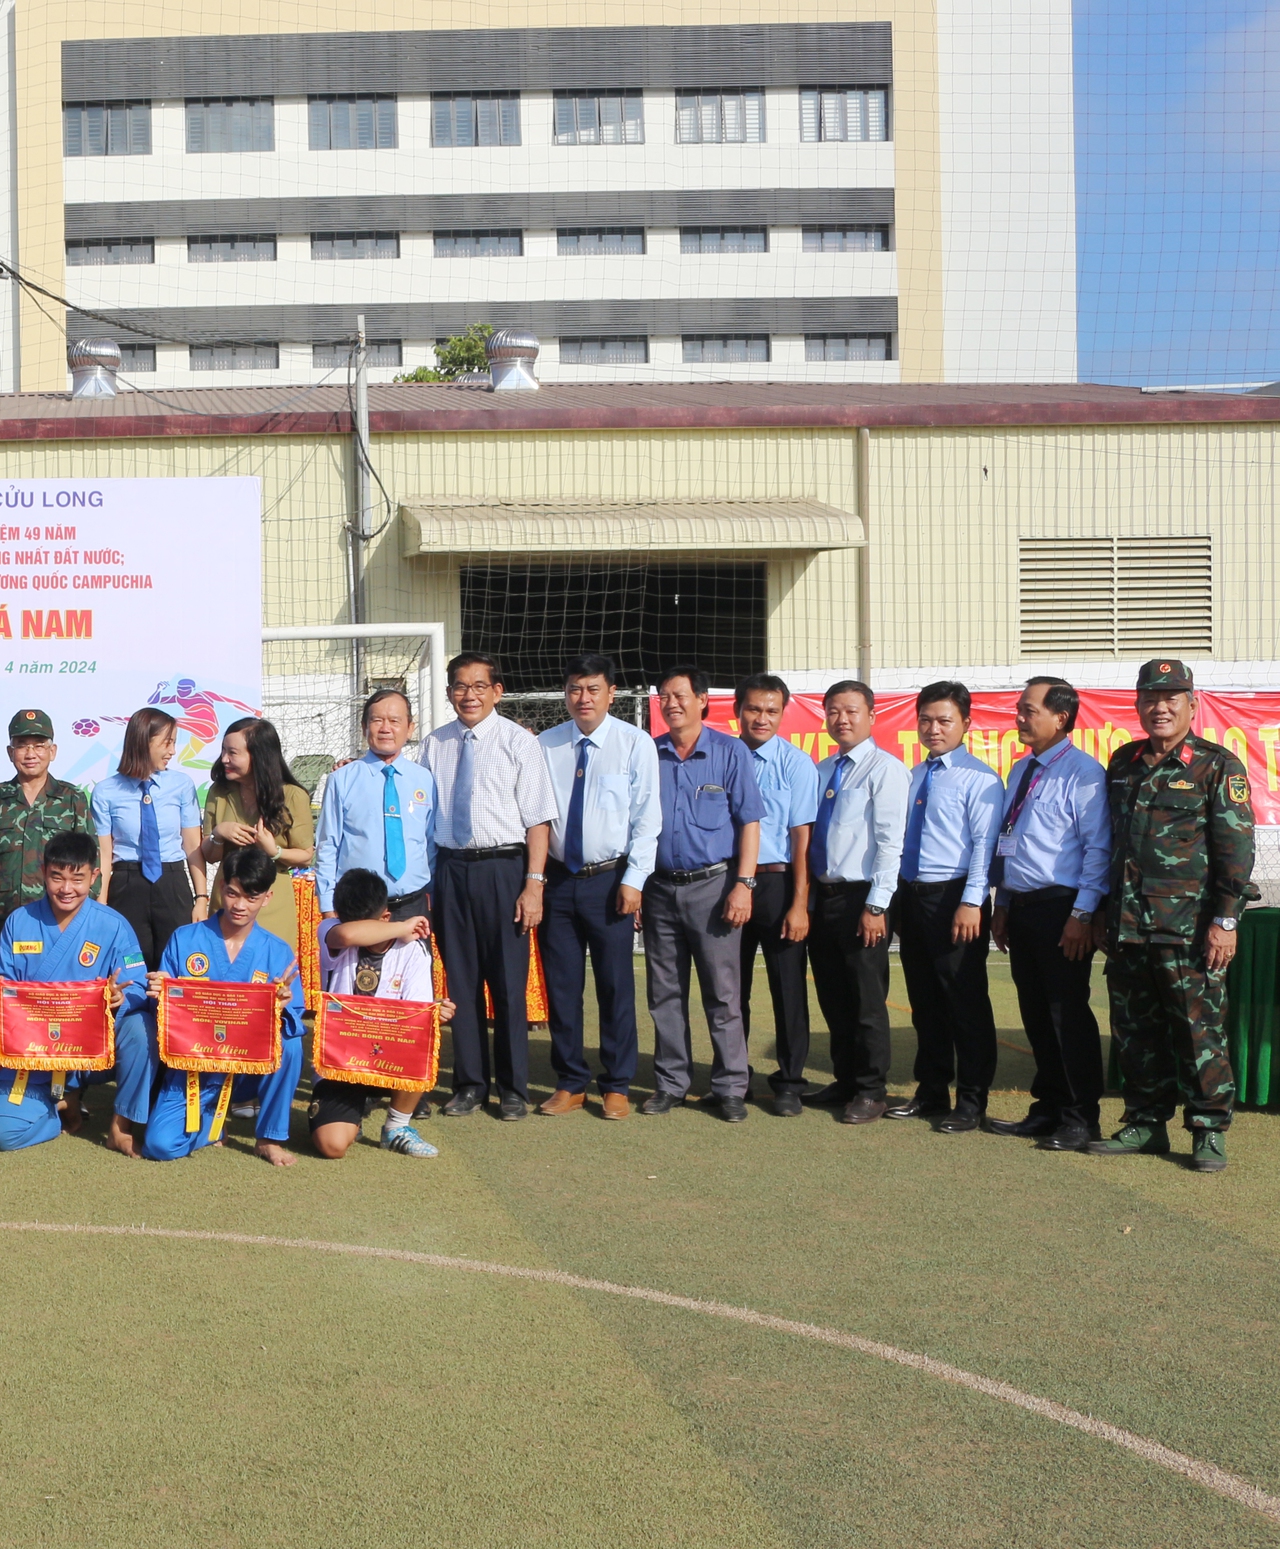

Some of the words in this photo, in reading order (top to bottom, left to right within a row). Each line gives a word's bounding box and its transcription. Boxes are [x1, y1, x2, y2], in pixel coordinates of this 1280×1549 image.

[42, 491, 103, 508] LONG
[24, 527, 41, 541] 49
[45, 524, 76, 540] NĂM
[15, 546, 50, 565] NHẤT
[53, 546, 79, 565] ĐẤT
[83, 547, 125, 566] NƯỚC;
[32, 570, 68, 591] QUỐC
[72, 574, 153, 589] CAMPUCHIA
[21, 609, 93, 640] NAM
[5, 661, 14, 674] 4
[19, 661, 53, 674] năm
[58, 660, 97, 674] 2024
